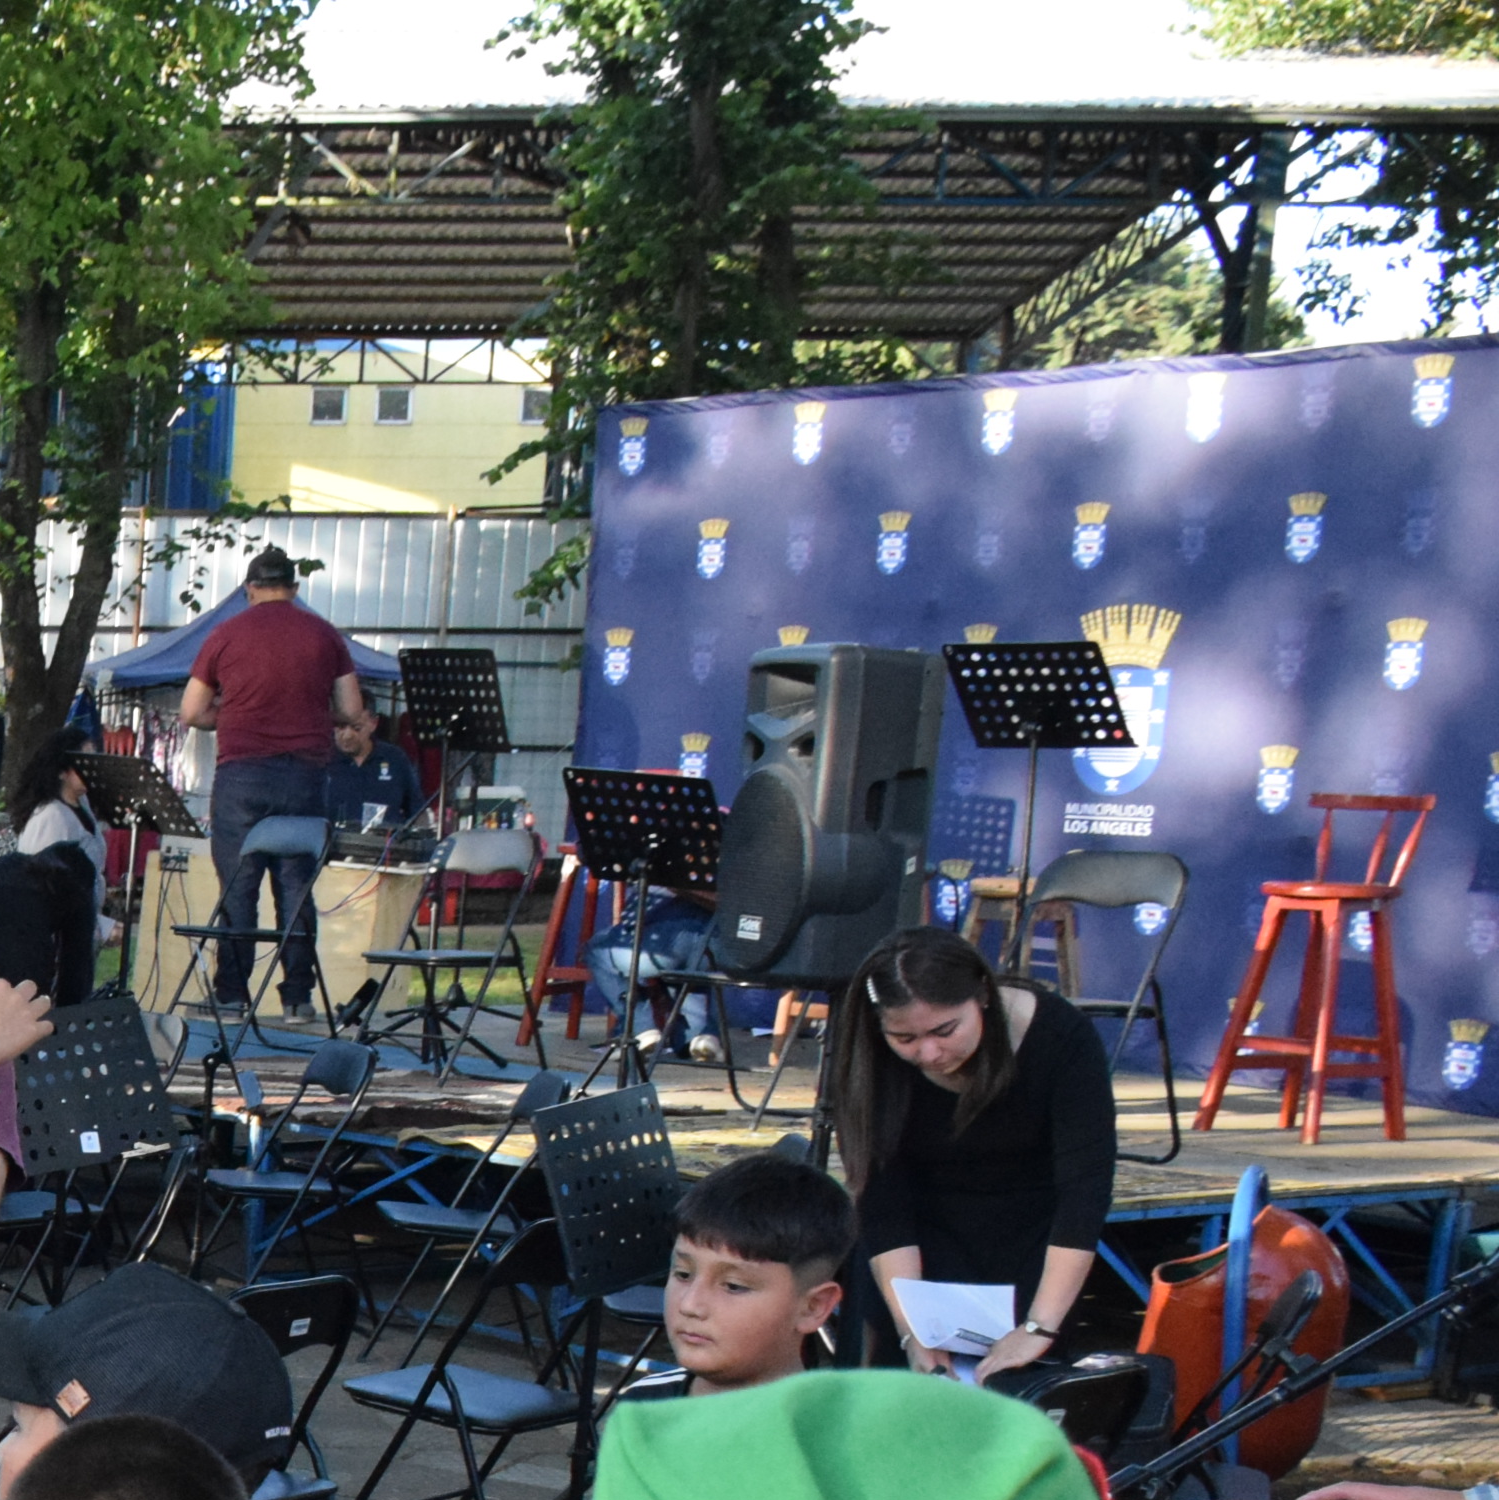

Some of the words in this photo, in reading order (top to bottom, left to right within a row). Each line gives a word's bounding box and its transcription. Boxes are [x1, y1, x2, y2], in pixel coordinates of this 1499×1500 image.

[1064, 802, 1154, 818] MUNICIPALIDAD
[1063, 820, 1088, 834] LOS
[1090, 821, 1152, 836] ANGELES
